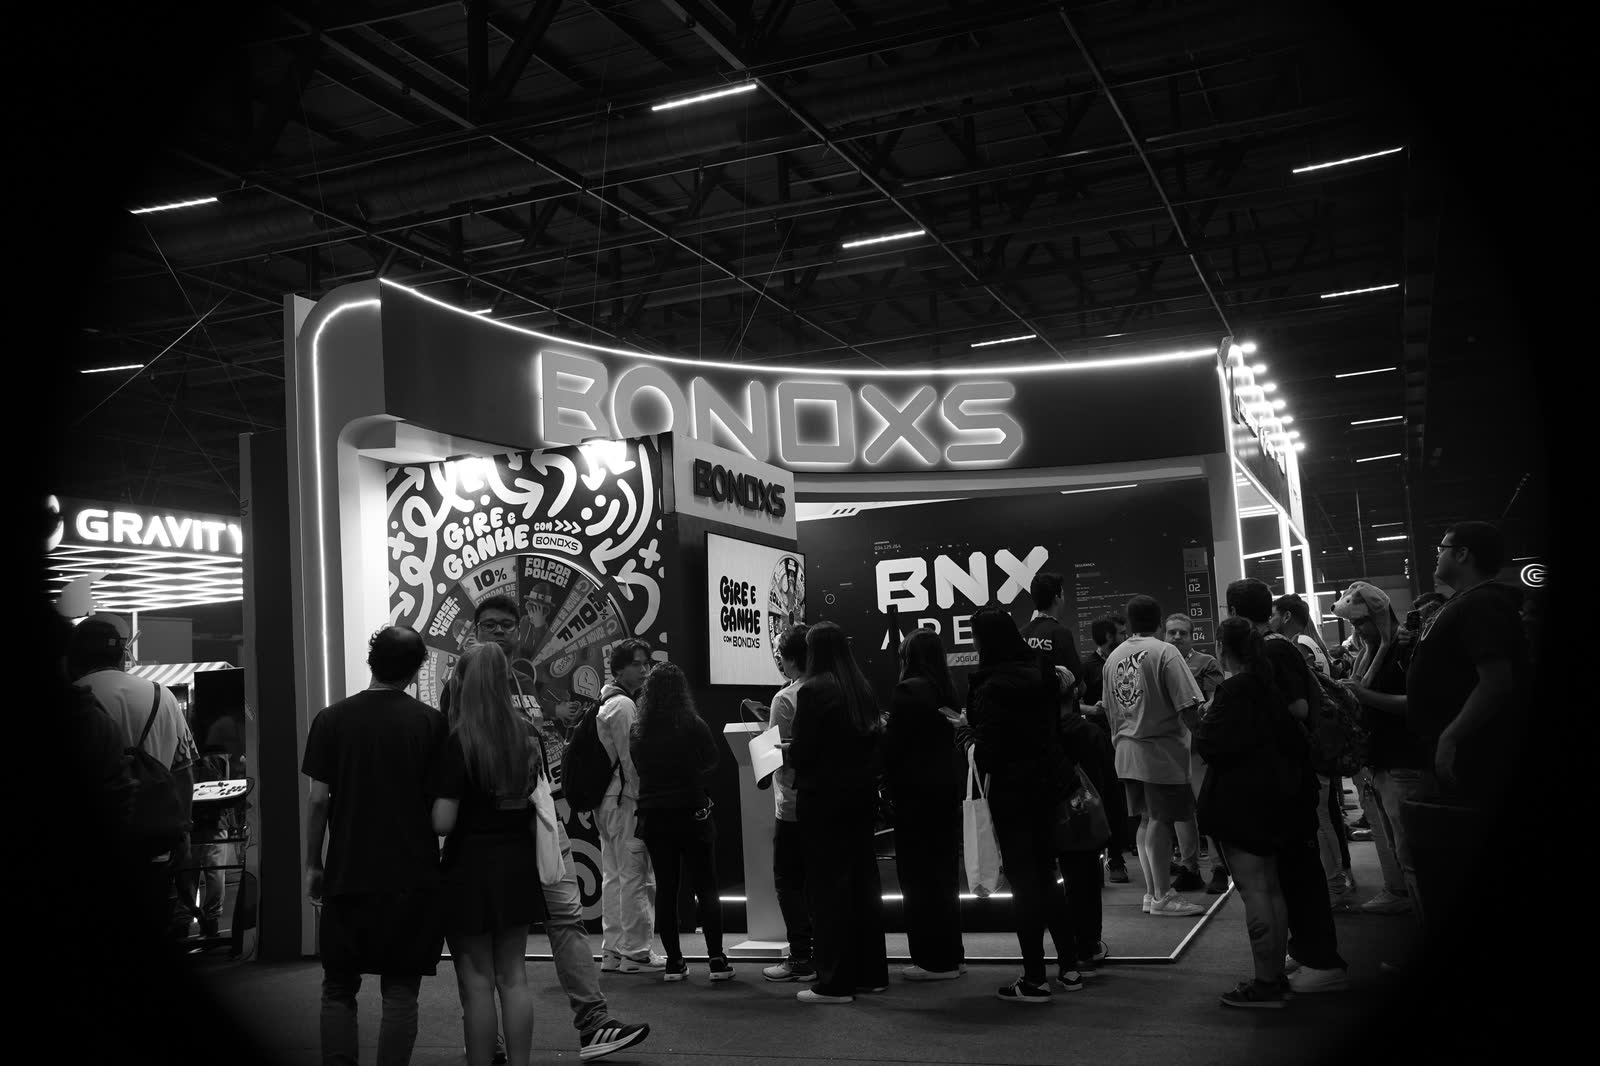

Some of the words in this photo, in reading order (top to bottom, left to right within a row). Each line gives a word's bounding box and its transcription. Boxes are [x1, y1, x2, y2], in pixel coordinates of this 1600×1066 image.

[443, 524, 530, 580] GANHE
[473, 567, 507, 592] 10%
[524, 567, 569, 588] POUCO!
[526, 557, 546, 571] FOI
[547, 561, 572, 580] POR
[875, 546, 1049, 614] BNX
[1188, 583, 1201, 592] 02
[438, 605, 461, 637] HEIN!
[720, 606, 761, 634] GANHE
[1190, 608, 1203, 617] 03
[1192, 632, 1205, 641] 04
[955, 654, 978, 663] JOGUE
